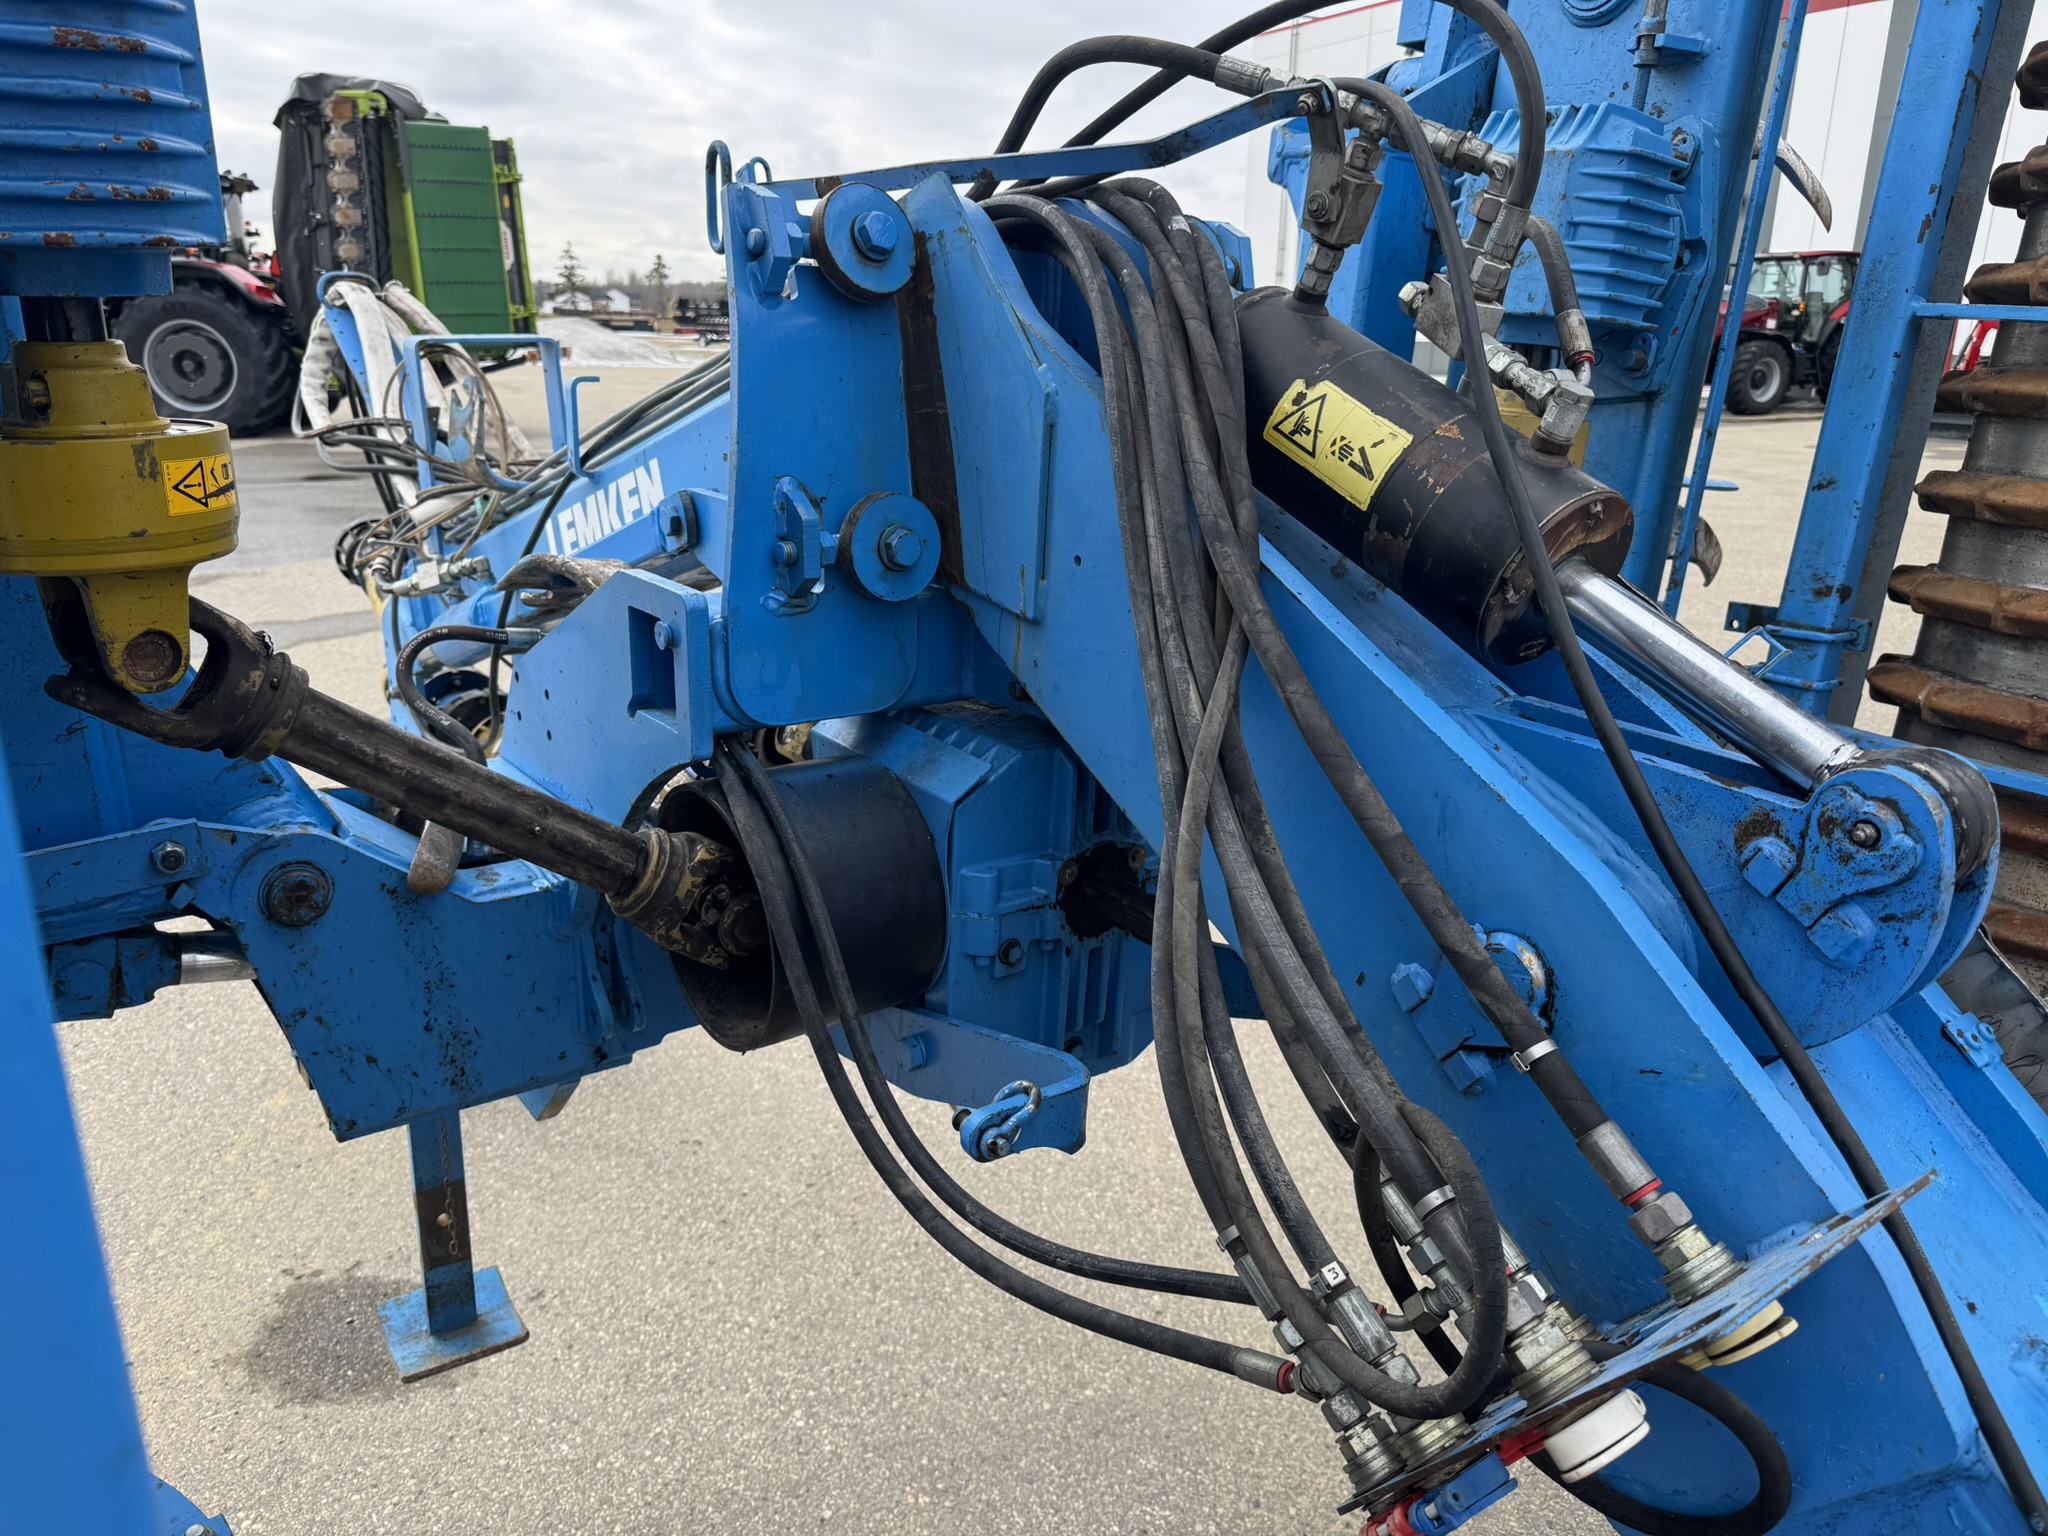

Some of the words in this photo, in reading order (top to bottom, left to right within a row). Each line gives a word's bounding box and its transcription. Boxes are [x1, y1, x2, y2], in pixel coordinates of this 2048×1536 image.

[545, 457, 665, 557] LEMKEN
[398, 631, 434, 670] CARBONITE
[1327, 1266, 1340, 1281] 3
